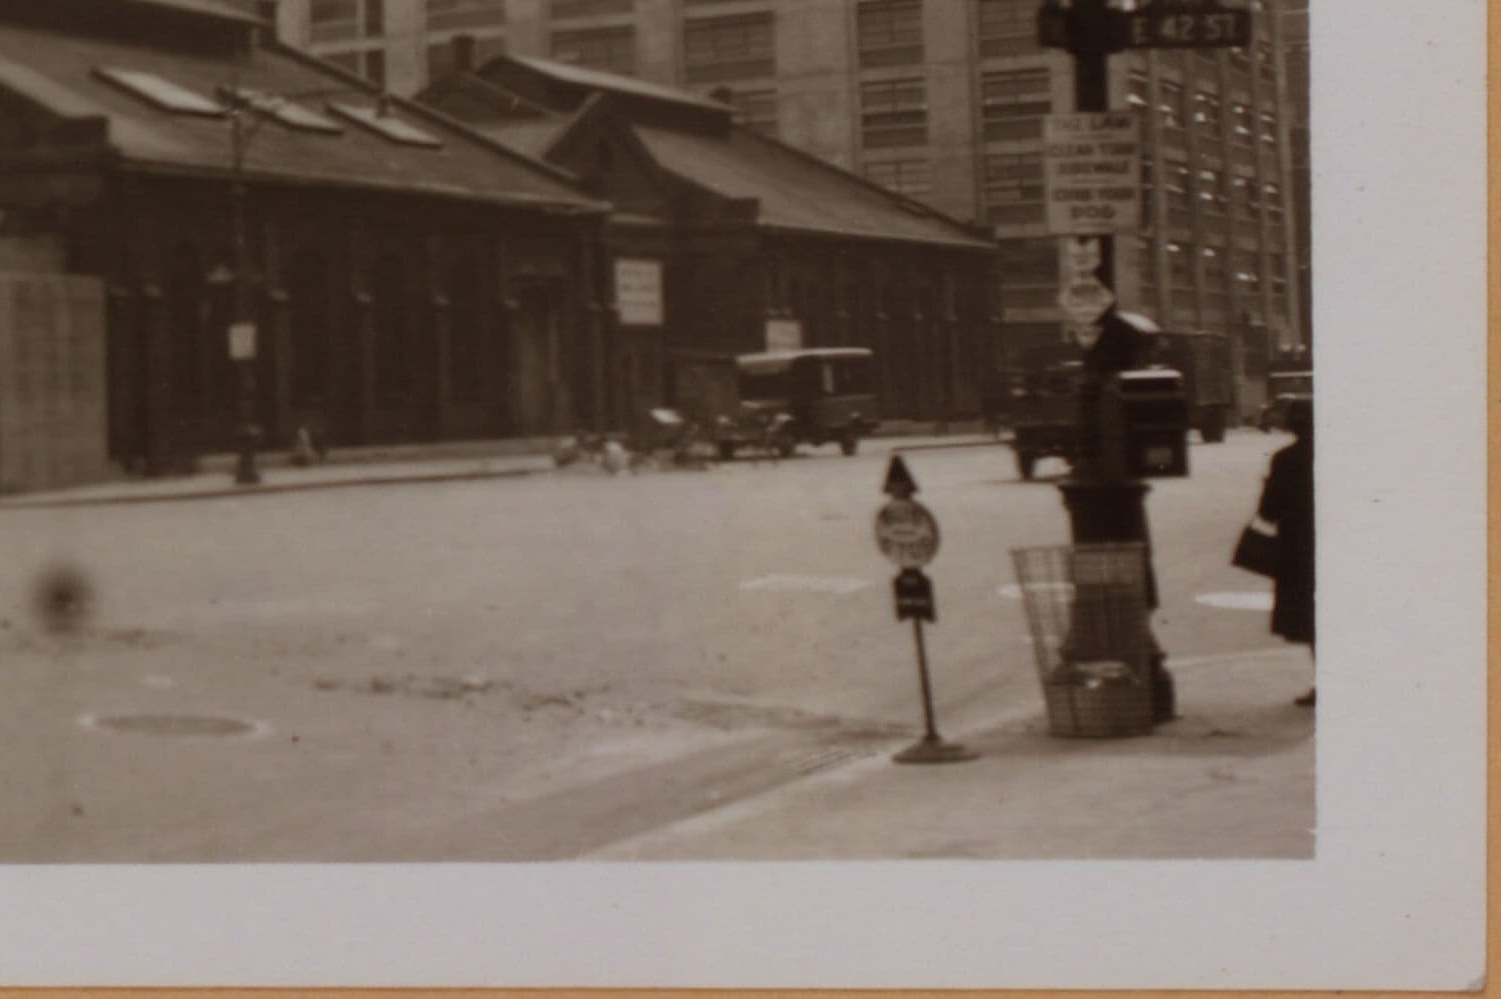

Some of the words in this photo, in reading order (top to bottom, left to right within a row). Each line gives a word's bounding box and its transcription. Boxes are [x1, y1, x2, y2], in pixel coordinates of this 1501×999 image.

[1133, 17, 1147, 43] E
[1160, 14, 1195, 41] 42
[1203, 13, 1236, 40] ST
[1070, 205, 1116, 219] DOG
